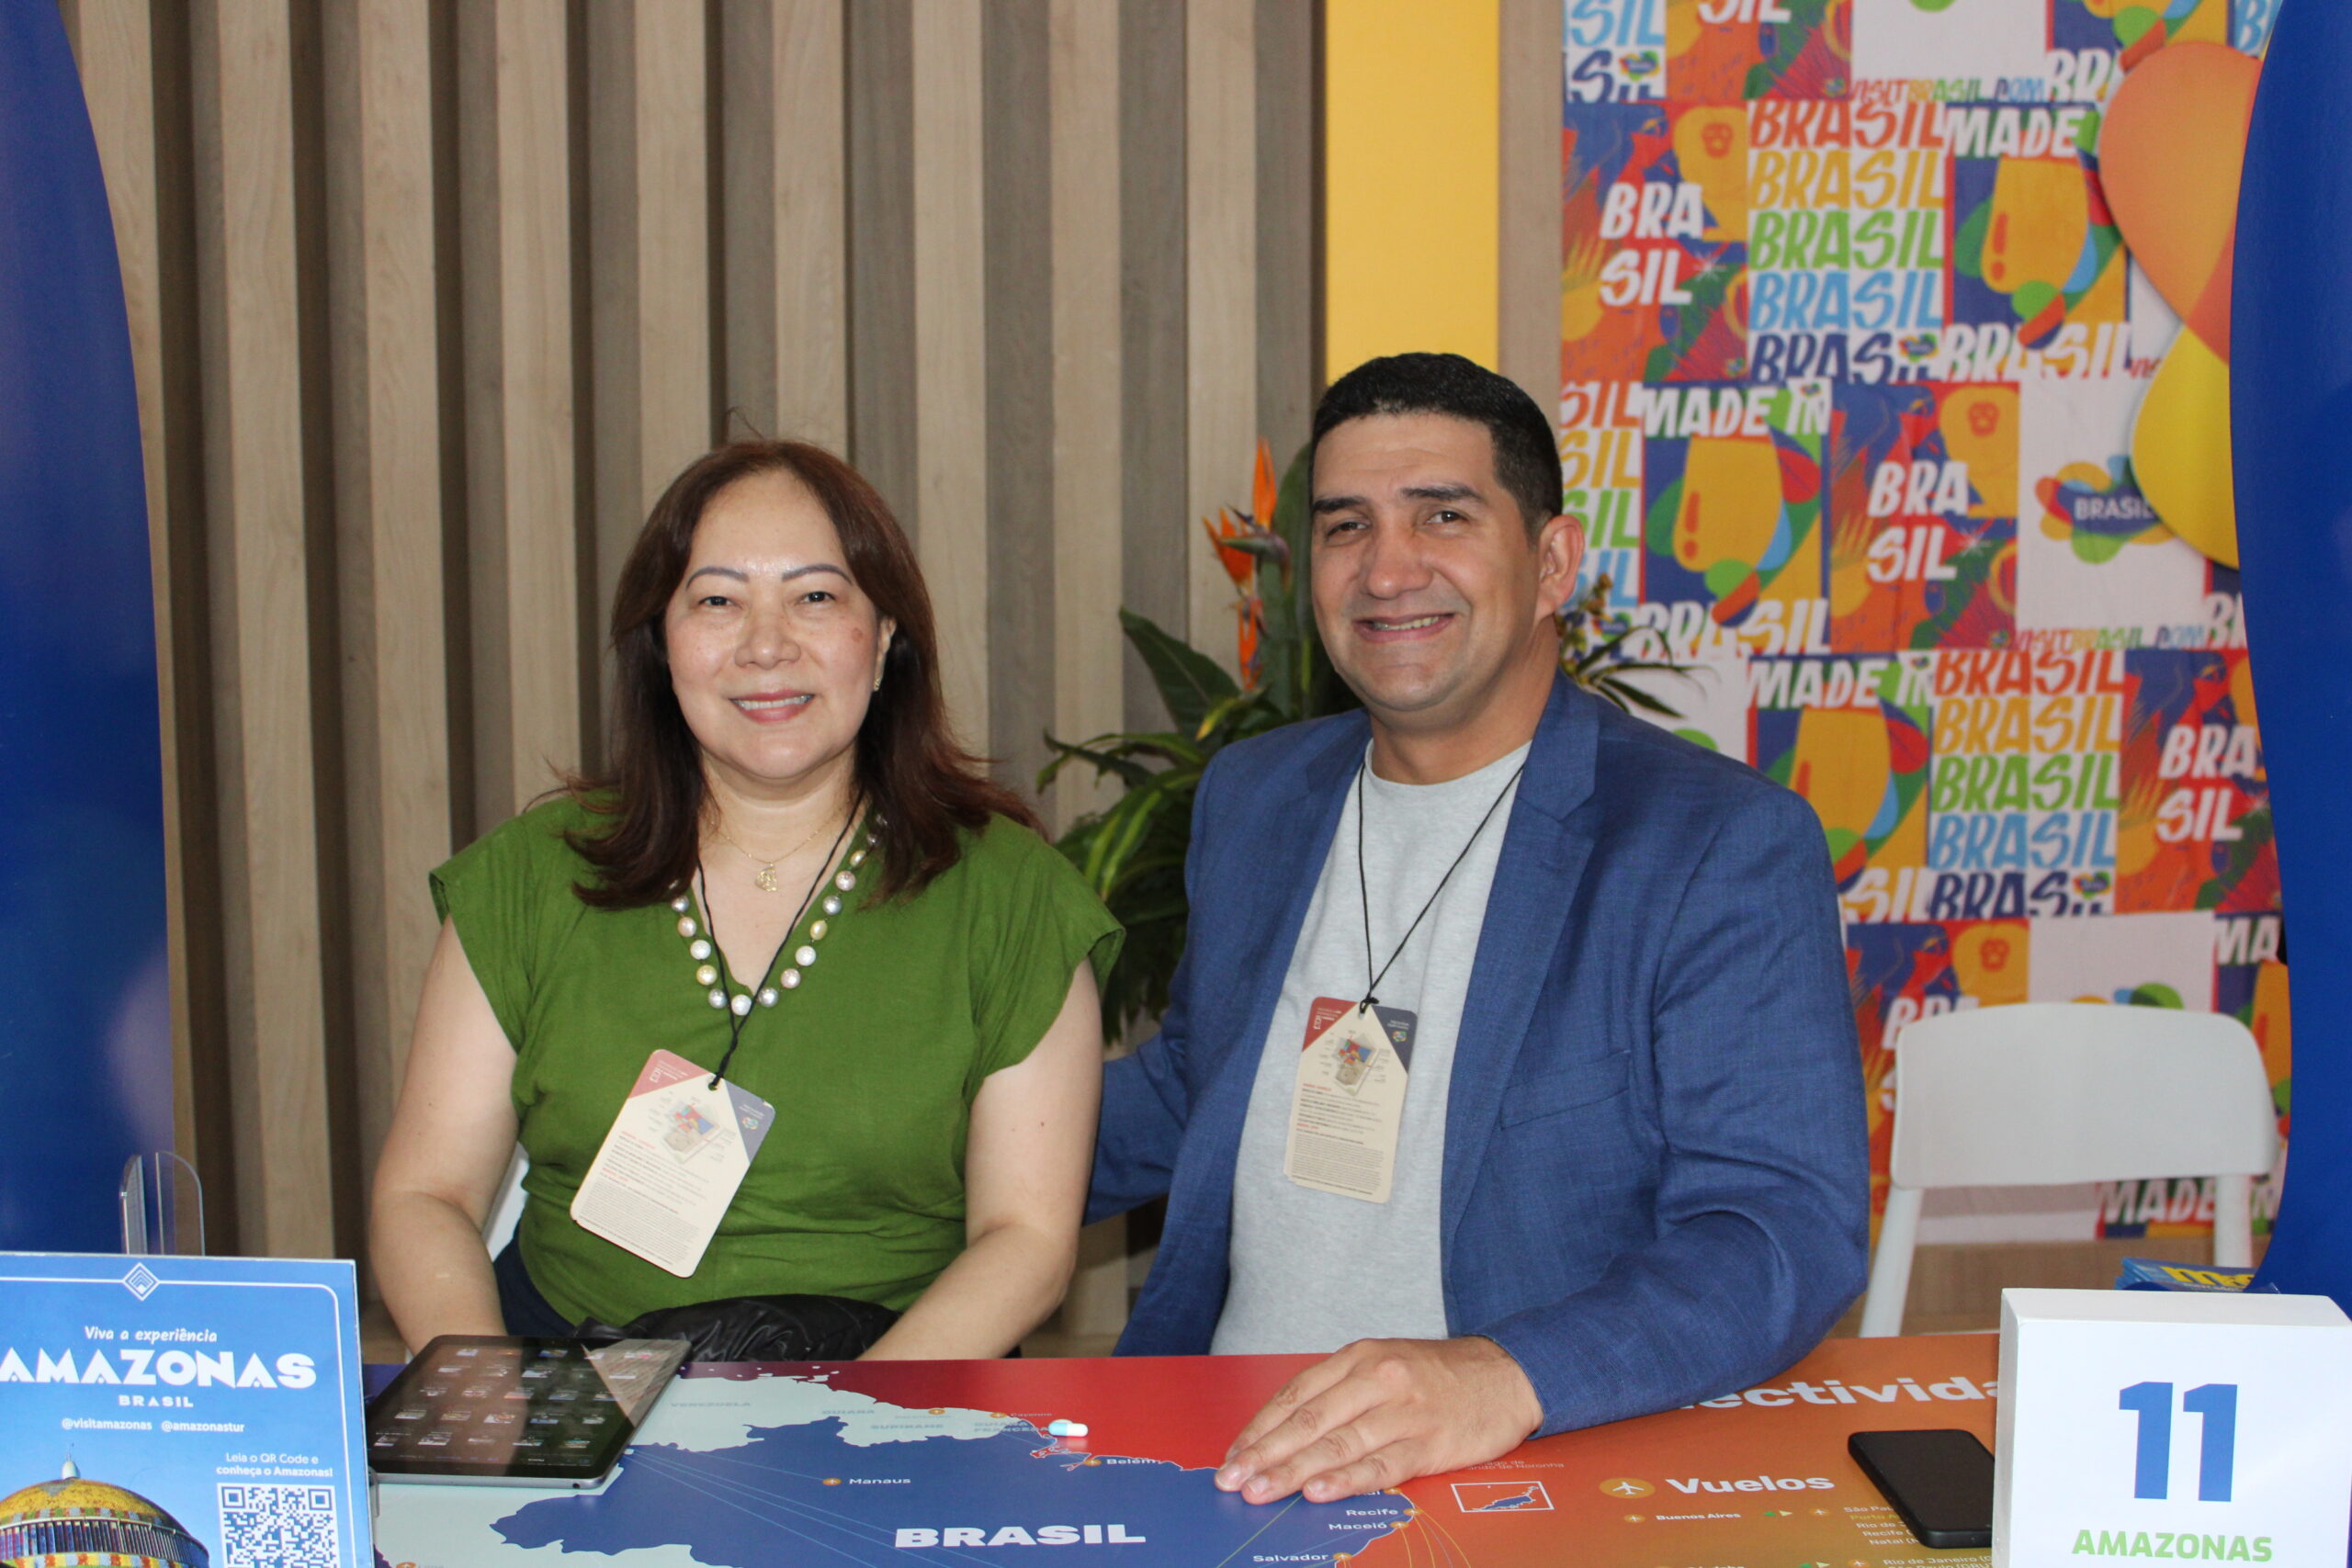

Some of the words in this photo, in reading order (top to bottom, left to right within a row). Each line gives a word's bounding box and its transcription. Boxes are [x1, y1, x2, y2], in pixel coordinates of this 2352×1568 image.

[1749, 101, 1945, 149] BRASIL
[1943, 107, 2087, 159] MADE
[1747, 150, 1945, 209] BRASIL
[1600, 182, 1704, 240] BRA
[1747, 210, 1944, 269] BRASIL
[1600, 249, 1692, 306] SIL
[1747, 271, 1944, 331] BRASIL
[1939, 322, 2132, 381] BRASIL
[1641, 385, 1779, 438] MADE
[1784, 377, 1833, 435] IN
[1867, 459, 1970, 517] BRA
[2075, 494, 2155, 522] BRASIL
[1867, 525, 1958, 582] SIL
[1747, 660, 1889, 710] MADE
[1933, 649, 2124, 696] BRASIL
[1932, 696, 2122, 754] BRASIL
[2159, 725, 2256, 780] BRA
[1931, 754, 2120, 812] BRASIL
[2155, 789, 2242, 842] SIL
[1930, 812, 2117, 871] BRASIL
[85, 1325, 114, 1339] Viva
[120, 1331, 130, 1340] a
[135, 1327, 218, 1344] experiência
[0, 1347, 317, 1389] AMAZONAS
[119, 1394, 194, 1407] BRASIL
[1680, 1376, 1997, 1410] ectivid
[62, 1417, 153, 1431] @visitamazonas
[161, 1420, 244, 1434] @amazonastur
[2119, 1382, 2238, 1502] 11
[216, 1465, 263, 1478] conheça
[273, 1466, 334, 1477] Amazonas!
[226, 1452, 248, 1463] Leia
[259, 1453, 277, 1465] QR
[278, 1453, 309, 1464] Code
[311, 1456, 319, 1465] e
[1665, 1474, 1836, 1495] Vuelos
[894, 1524, 1147, 1549] BRASIL
[1329, 1521, 1387, 1530] Maceió
[1345, 1508, 1398, 1517] Recife
[1252, 1553, 1329, 1562] Salvador
[1927, 1556, 1977, 1564] Janeiro
[2072, 1529, 2272, 1562] AMAZONAS
